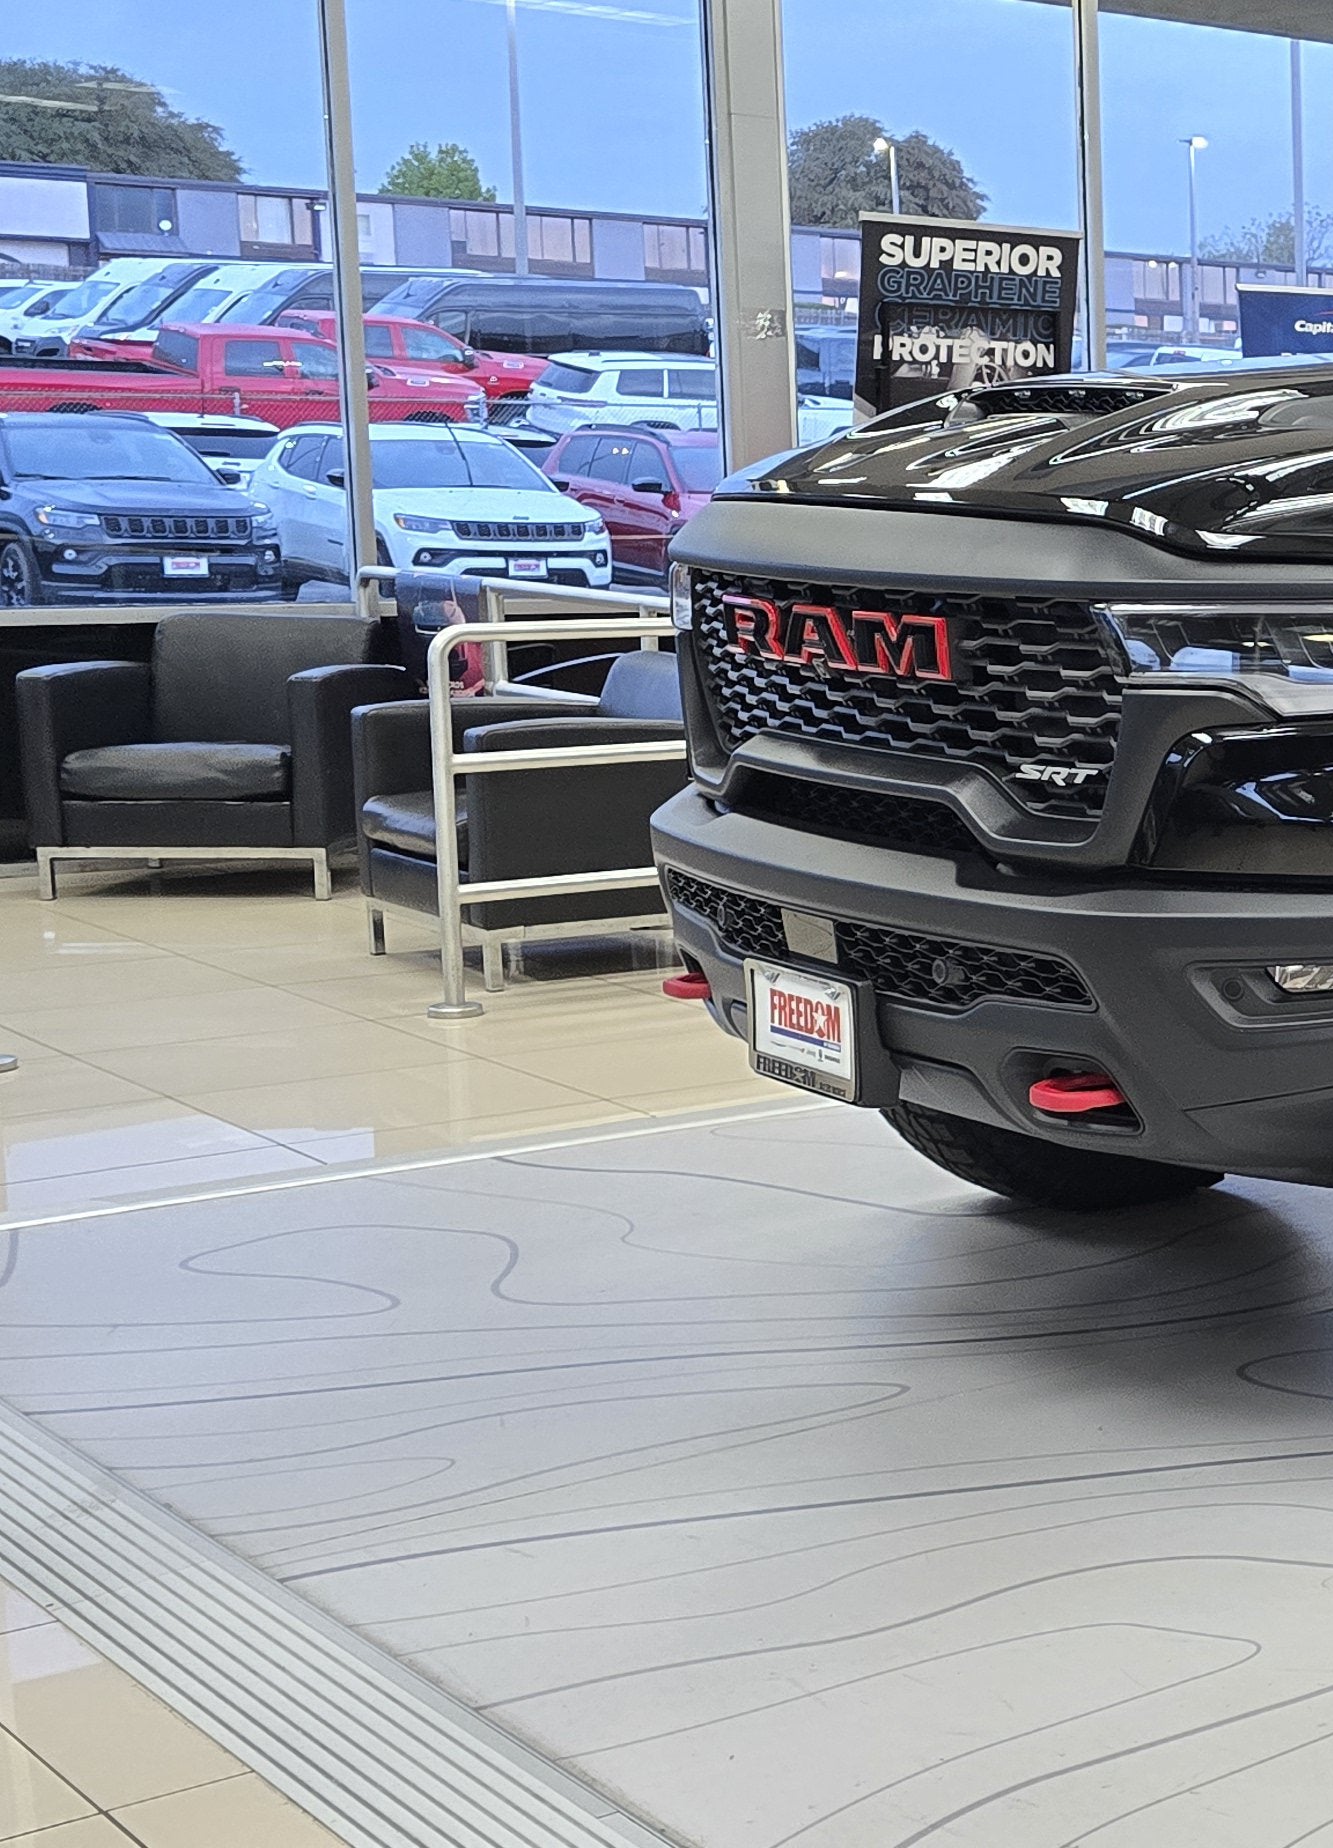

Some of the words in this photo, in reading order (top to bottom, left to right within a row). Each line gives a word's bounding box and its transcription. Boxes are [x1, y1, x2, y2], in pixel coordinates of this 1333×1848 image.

[878, 232, 1063, 278] SUPERIOR
[876, 266, 1062, 308] GRAPHENE
[722, 594, 953, 682] RAM
[1015, 762, 1100, 787] SRT
[769, 986, 842, 1044] FREEDOM
[756, 1053, 817, 1089] FREEDOM
